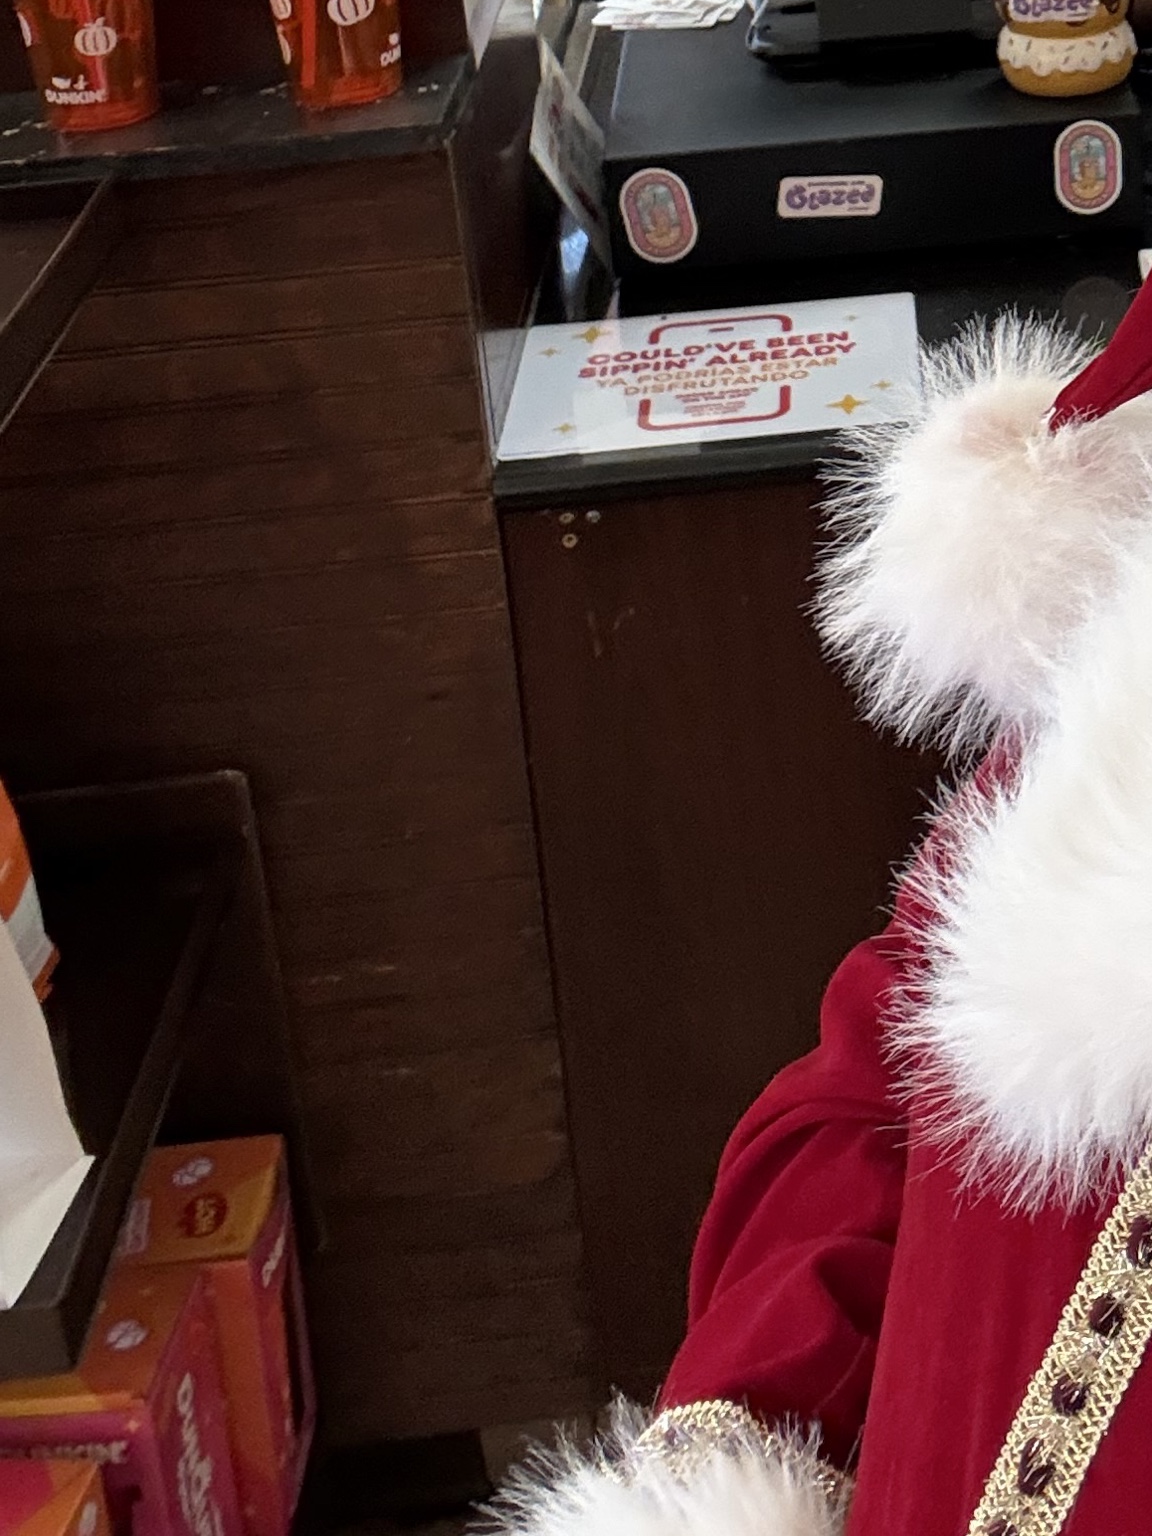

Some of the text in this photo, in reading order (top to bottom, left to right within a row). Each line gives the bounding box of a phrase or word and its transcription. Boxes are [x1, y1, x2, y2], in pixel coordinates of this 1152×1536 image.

[785, 184, 875, 210] Glazed
[578, 342, 857, 378] SIPPIN' ALREADY
[588, 331, 849, 365] COULD'VE BEEN
[597, 378, 628, 388] YA
[761, 357, 838, 372] ESTAR
[624, 370, 810, 395] DISFRUTANDO
